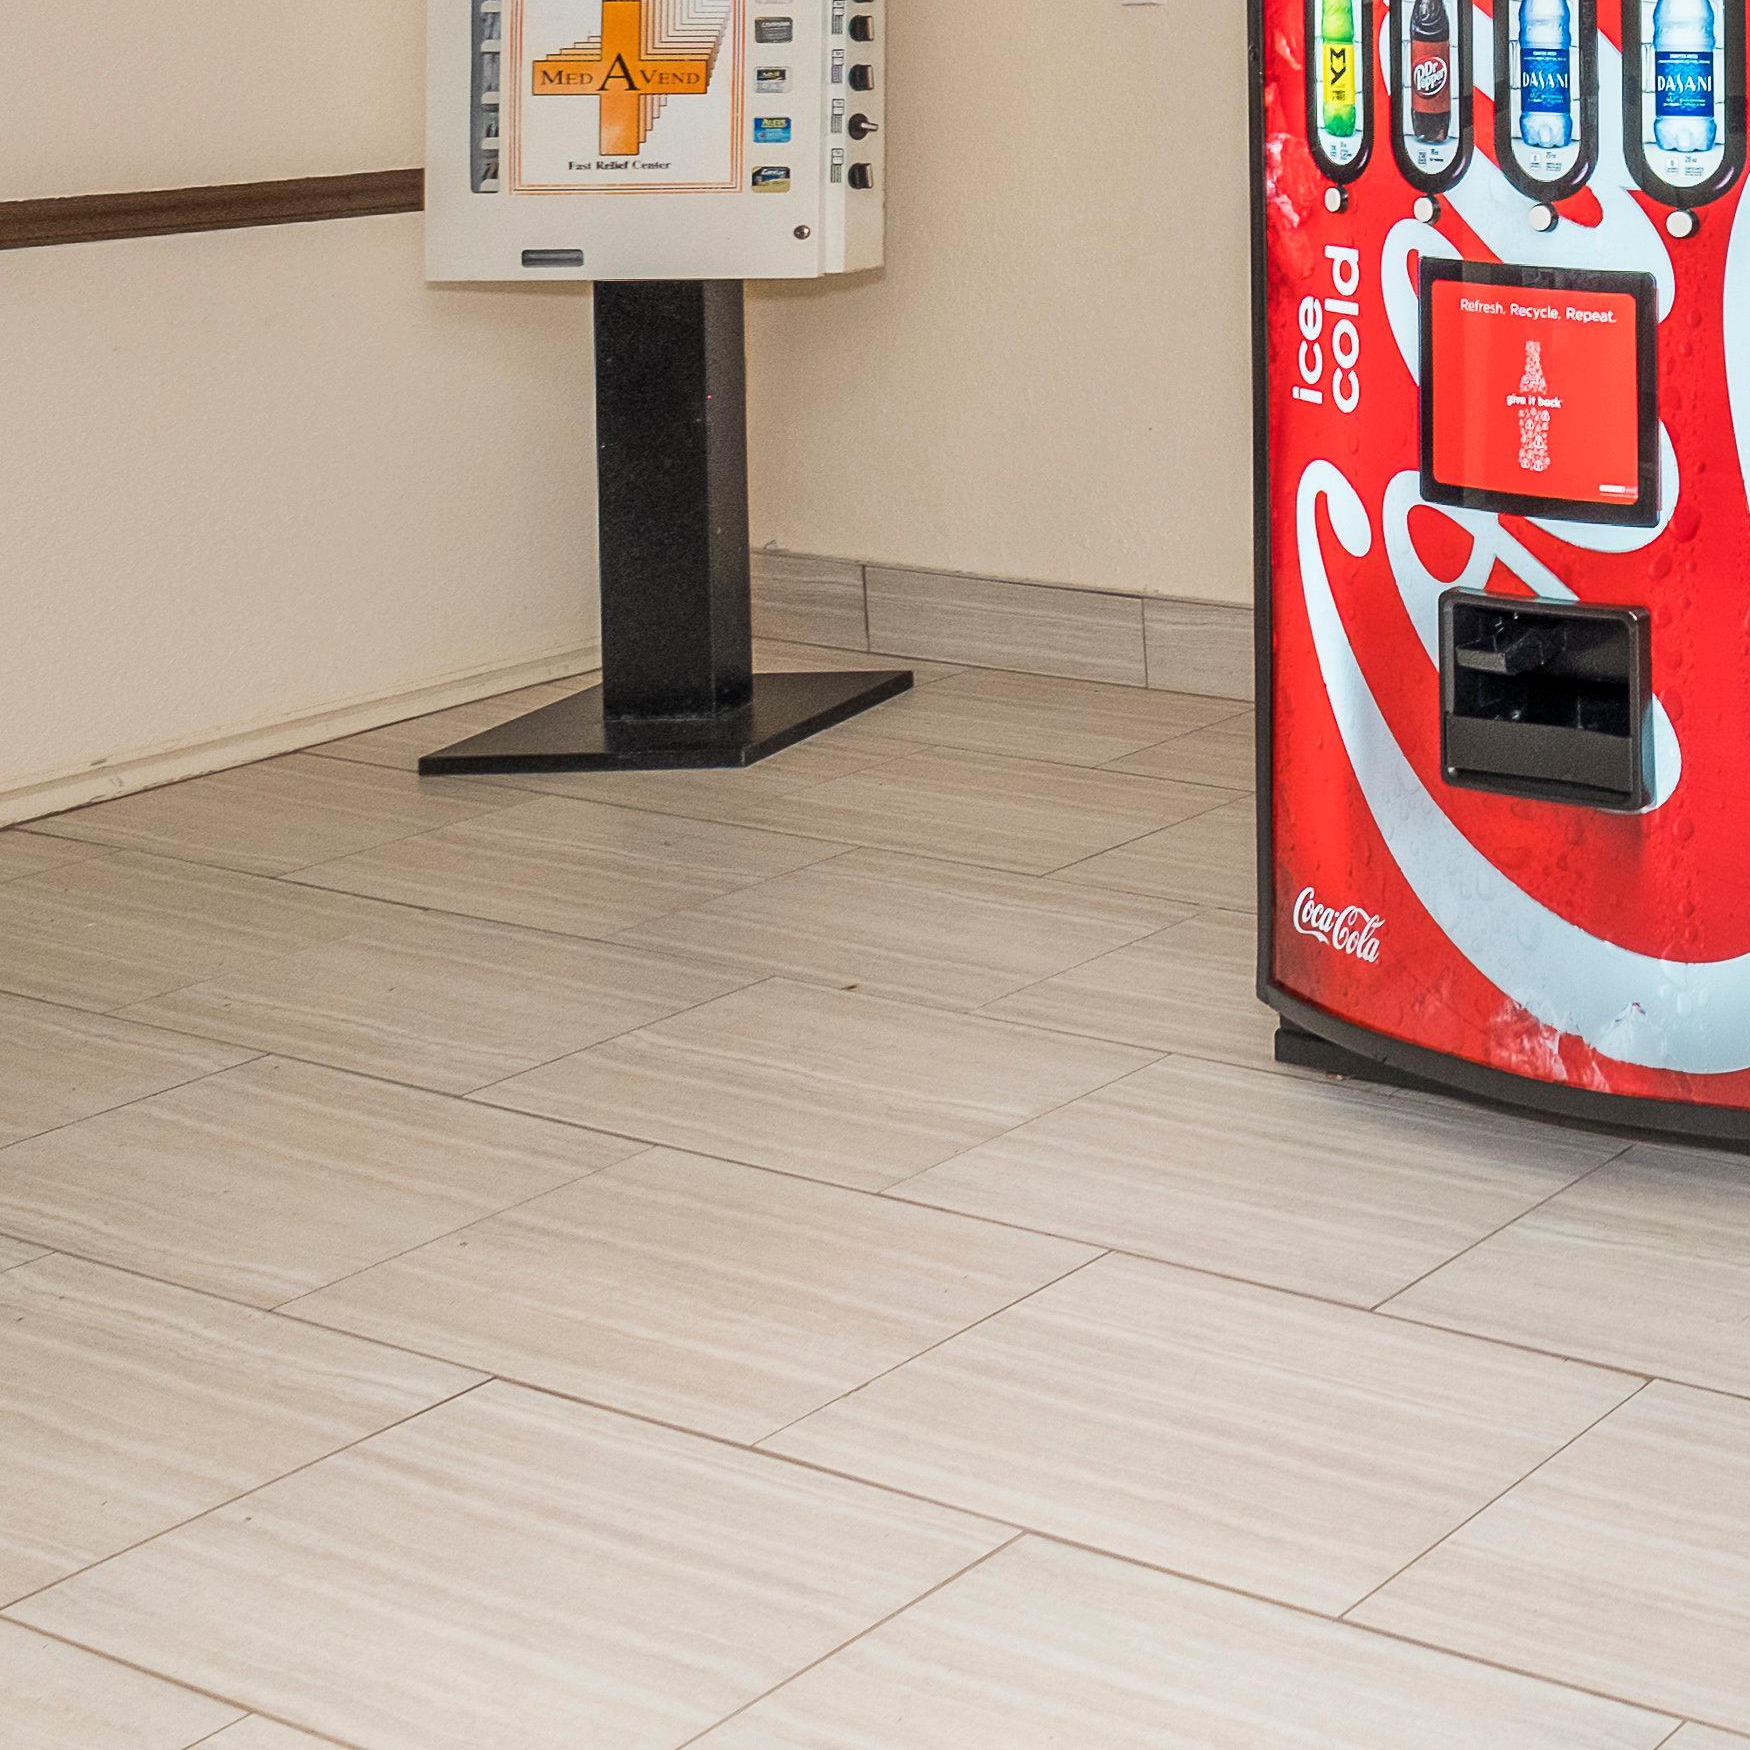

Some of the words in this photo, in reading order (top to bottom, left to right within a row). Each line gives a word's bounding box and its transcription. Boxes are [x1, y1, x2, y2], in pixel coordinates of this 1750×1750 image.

[597, 53, 640, 91] A
[1414, 62, 1444, 92] Pepper
[1421, 59, 1439, 74] Dr
[1522, 71, 1568, 89] DASANI
[1657, 75, 1712, 94] DASANI
[596, 160, 628, 170] Relief
[632, 160, 671, 170] Center
[1460, 298, 1506, 315] Refresh.
[1510, 303, 1561, 320] Recycle.
[1565, 307, 1616, 323] Repeat.
[1324, 244, 1360, 413] cold
[1292, 295, 1323, 405] ice
[1506, 394, 1526, 406] give
[1528, 395, 1536, 405] it
[1537, 396, 1562, 408] back
[1293, 886, 1386, 963] Coca-Cola
